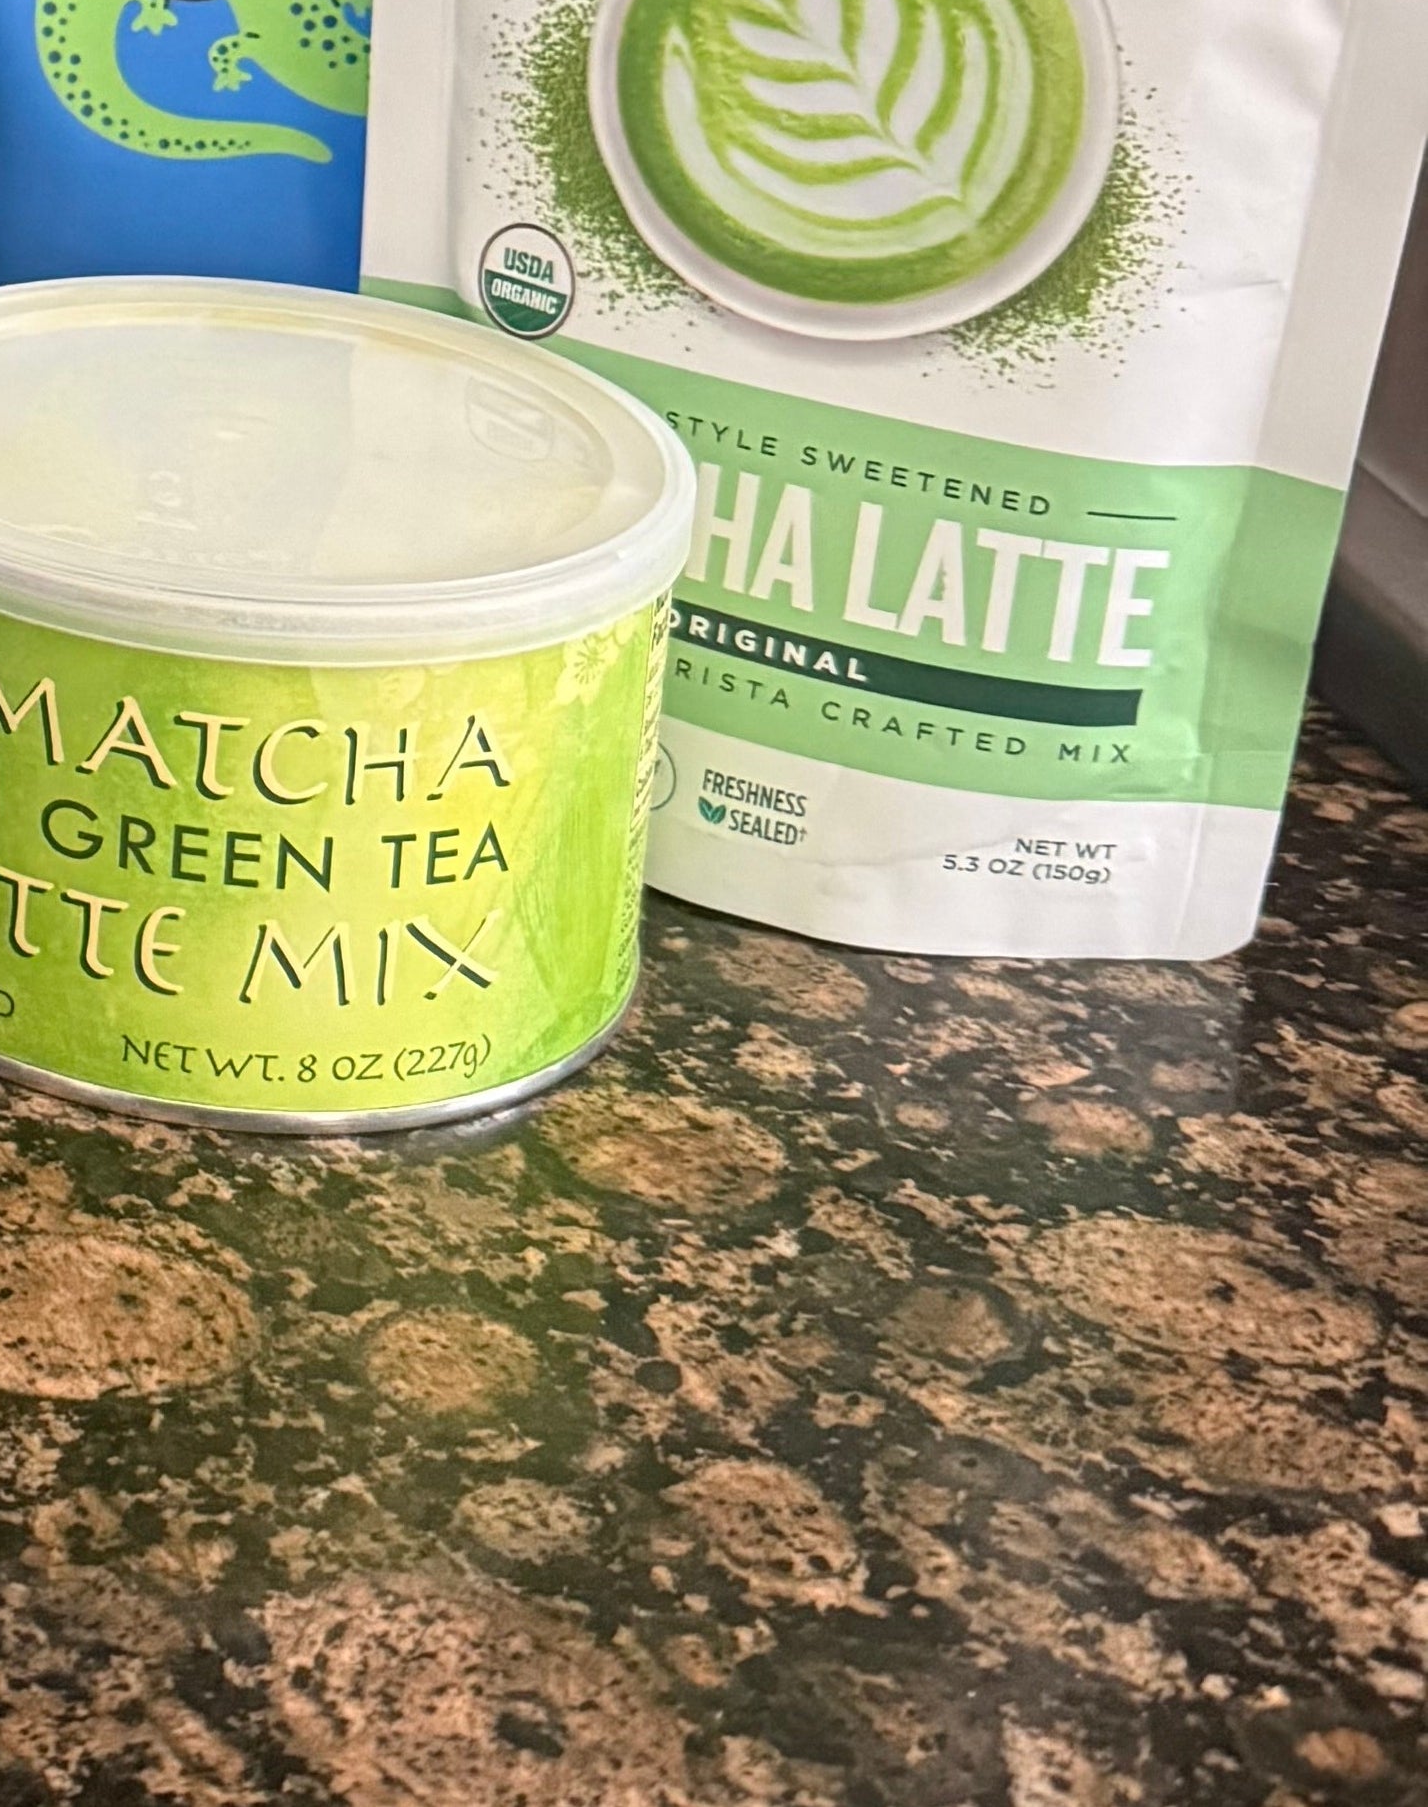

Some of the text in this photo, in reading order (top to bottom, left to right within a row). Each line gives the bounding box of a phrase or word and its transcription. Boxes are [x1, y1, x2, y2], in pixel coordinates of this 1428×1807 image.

[503, 247, 554, 284] USDA
[491, 278, 558, 315] ORGANIC
[665, 411, 1052, 518] STYLE SWEETENED
[842, 500, 1170, 669] LATTE
[667, 608, 870, 683] ORIGINAL
[674, 657, 1131, 766] RISTA CRAFTED MIX
[702, 769, 808, 817] FRESHNESS
[43, 798, 508, 891] GREEN TEA
[942, 854, 1111, 885] 5.3 OZ (150g)
[1015, 838, 1117, 860] NET WT
[239, 909, 504, 1007] MIX
[122, 1034, 491, 1082] NET WT. 8 OZ (227g)
